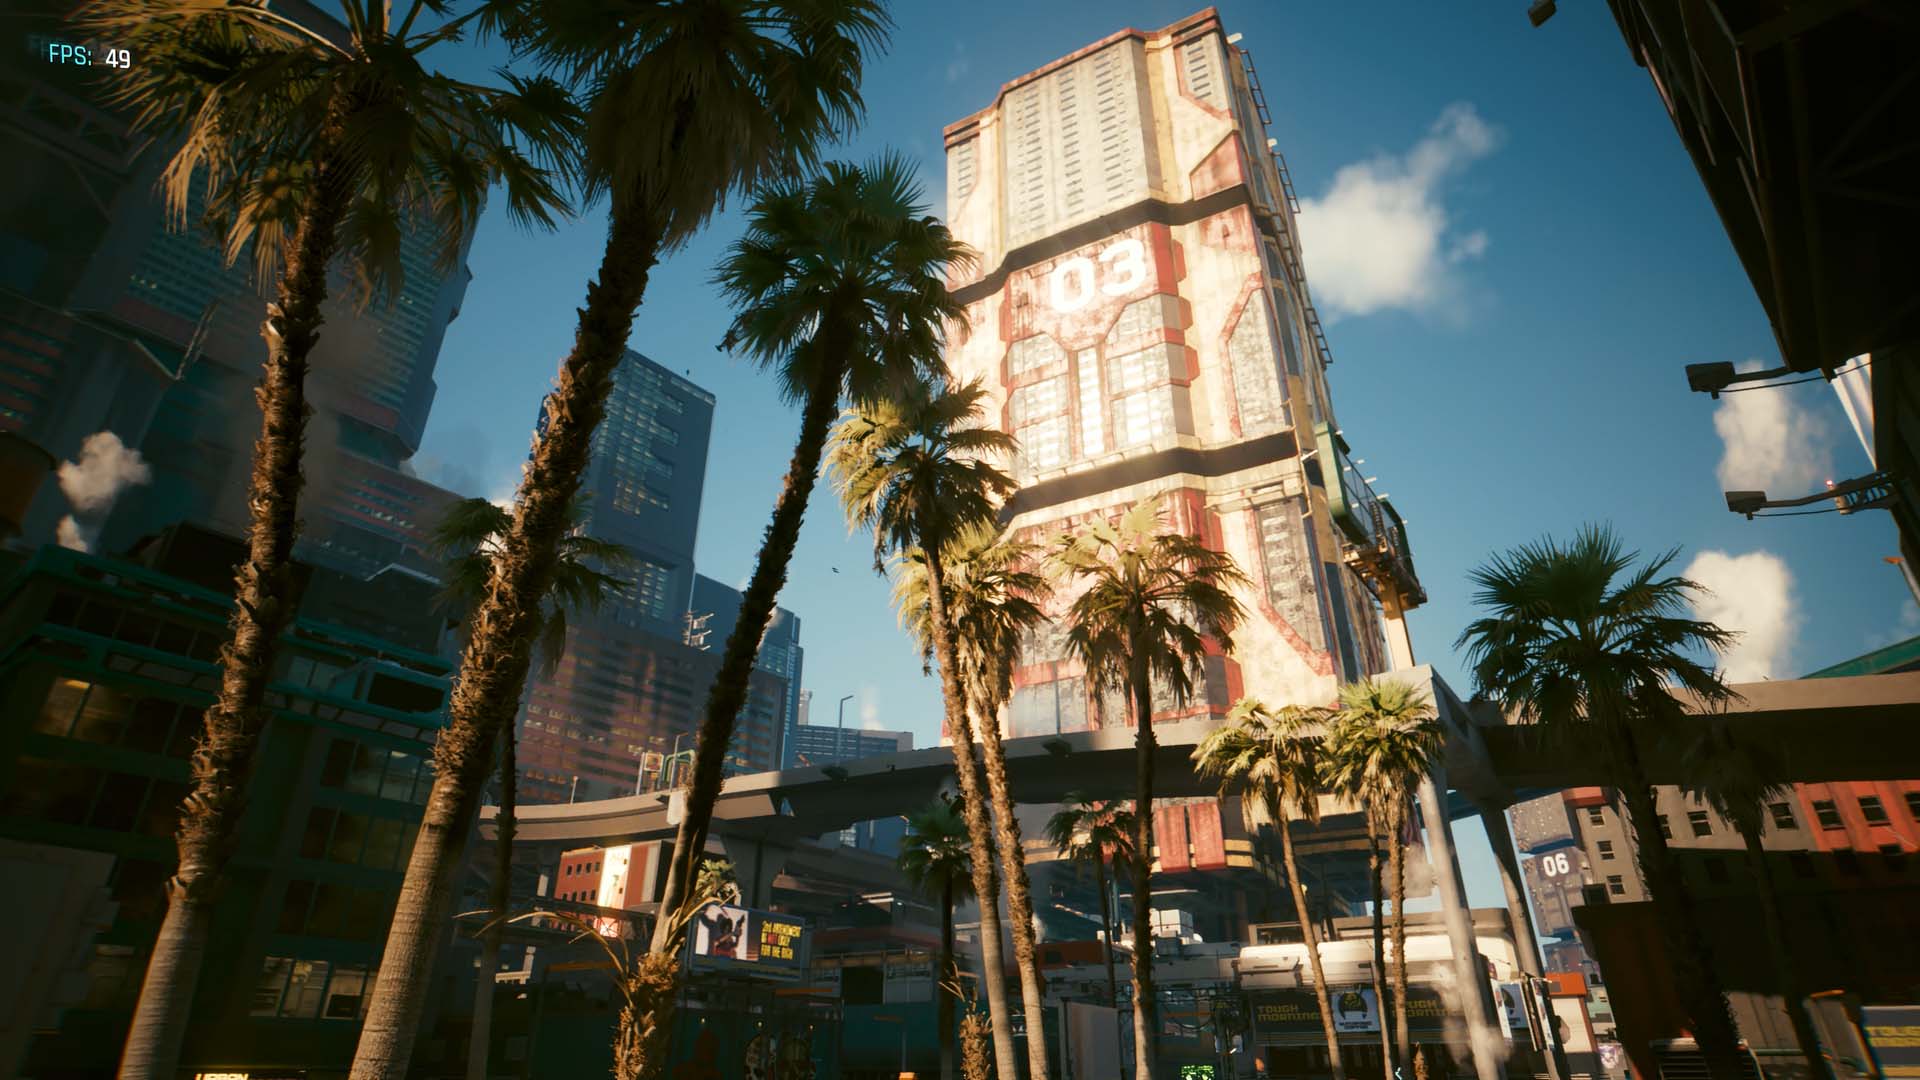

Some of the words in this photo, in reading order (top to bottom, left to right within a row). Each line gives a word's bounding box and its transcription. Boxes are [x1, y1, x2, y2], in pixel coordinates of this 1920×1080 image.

[1049, 238, 1145, 313] 03
[1543, 852, 1570, 877] 06
[1257, 1004, 1298, 1013] TOUGH
